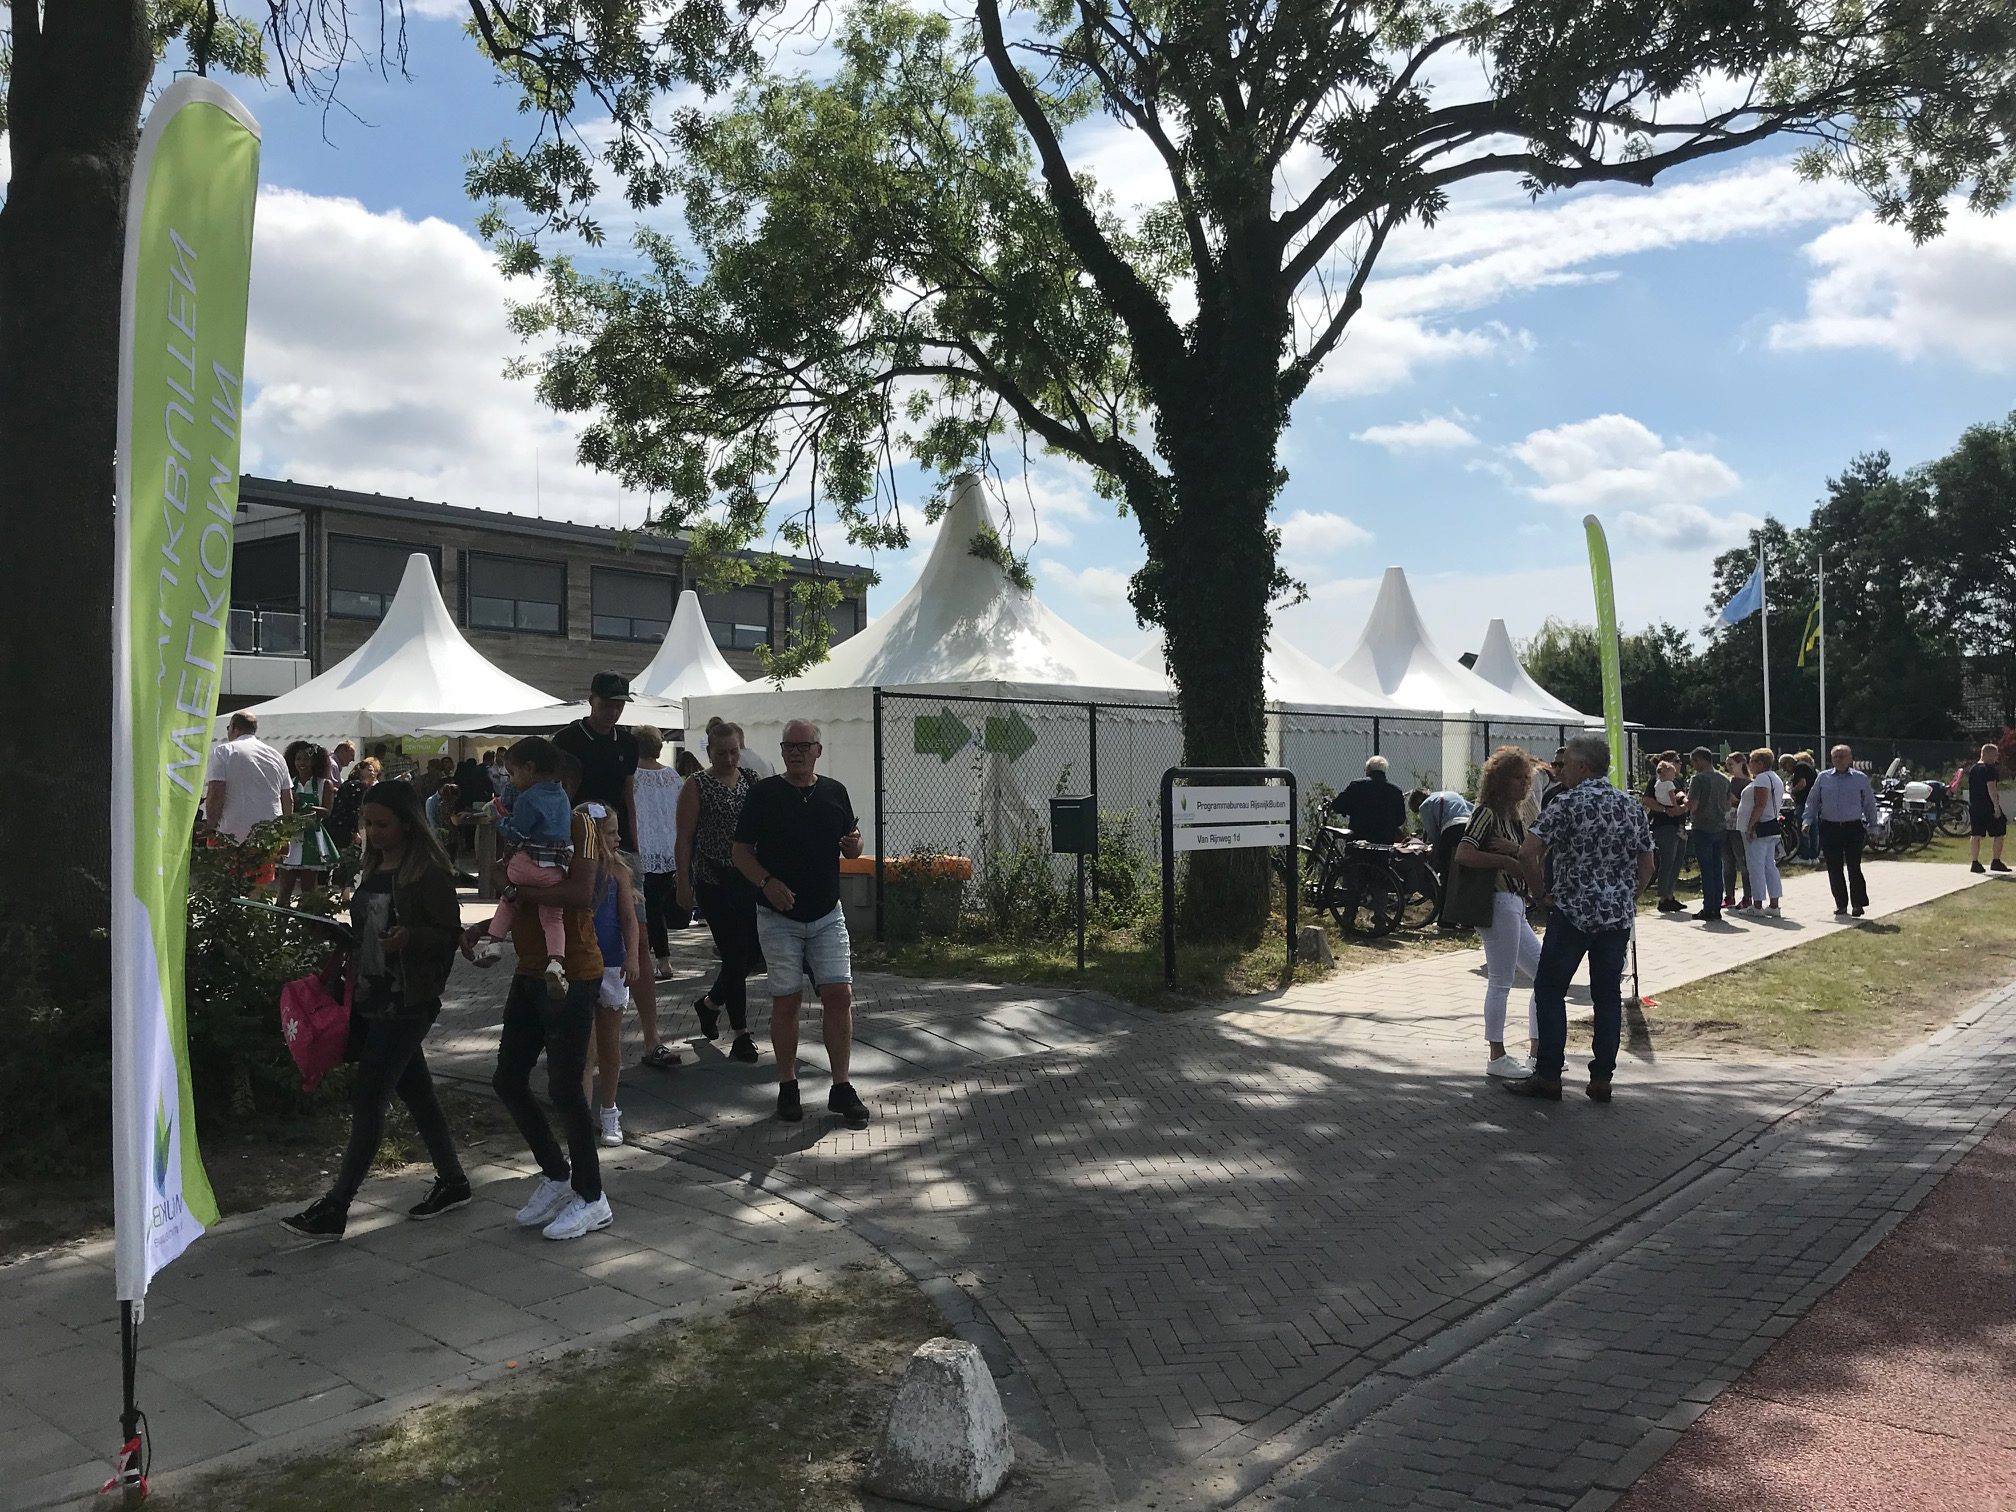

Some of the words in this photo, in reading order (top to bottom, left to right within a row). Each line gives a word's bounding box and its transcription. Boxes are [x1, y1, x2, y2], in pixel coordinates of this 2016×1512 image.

[1197, 802, 1249, 811] Programmabureau
[1197, 834, 1209, 844] Van
[1209, 833, 1232, 844] Rijnweg
